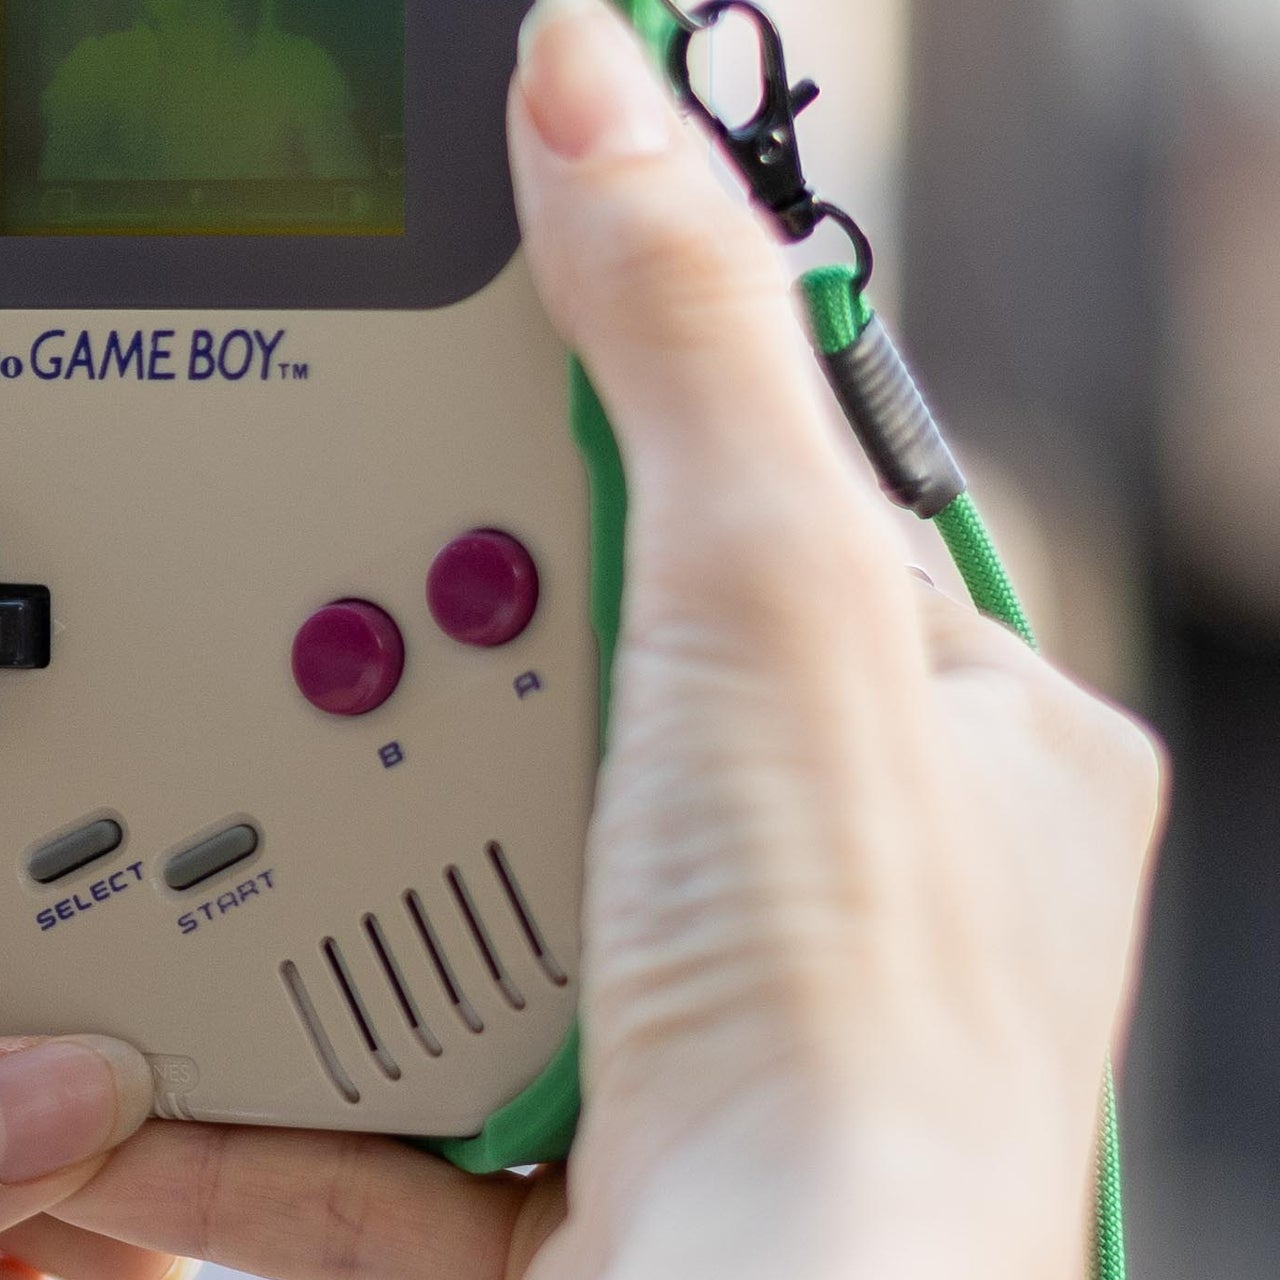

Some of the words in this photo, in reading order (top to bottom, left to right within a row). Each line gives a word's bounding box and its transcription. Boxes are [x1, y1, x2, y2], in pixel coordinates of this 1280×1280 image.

[30, 329, 176, 381] GAME
[513, 671, 540, 700] A
[377, 741, 404, 769] B
[36, 861, 143, 932] SELECT
[177, 869, 274, 935] START
